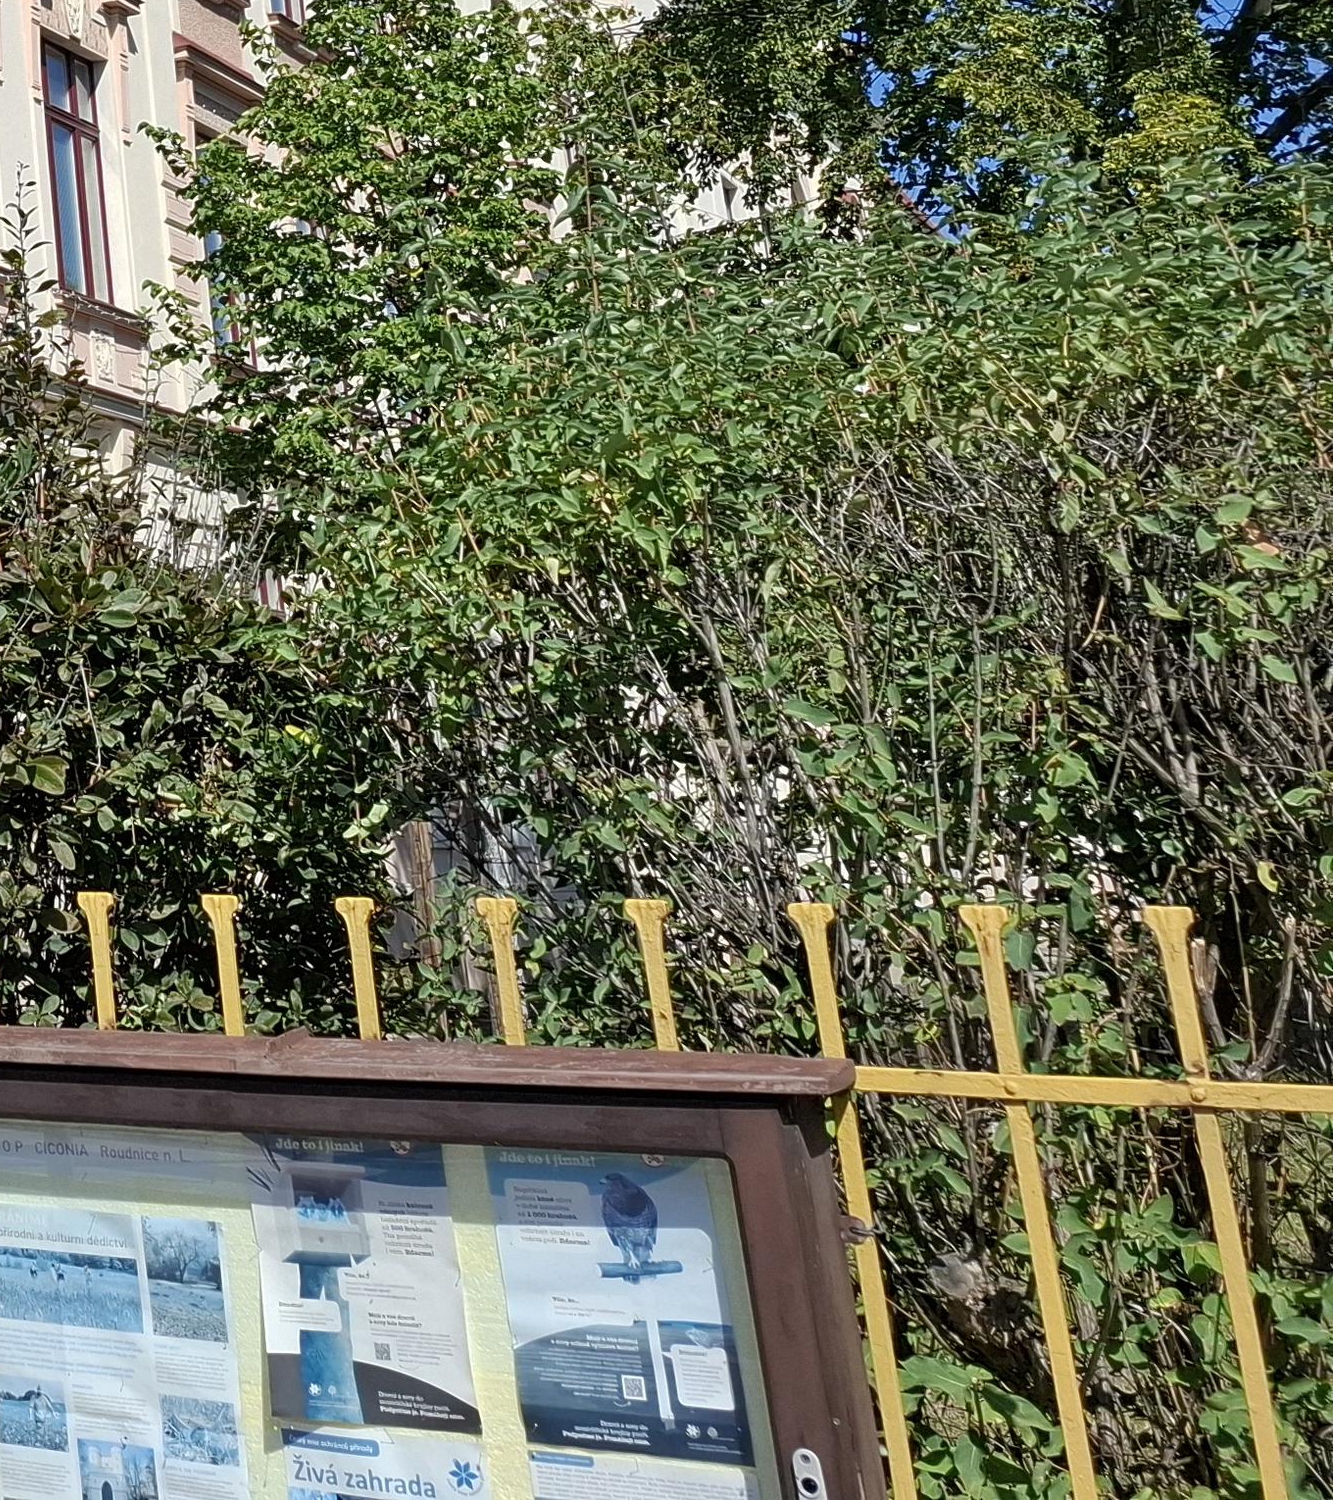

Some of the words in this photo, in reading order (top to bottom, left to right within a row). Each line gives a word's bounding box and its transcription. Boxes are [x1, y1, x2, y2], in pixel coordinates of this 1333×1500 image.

[35, 1140, 89, 1156] CICONIA
[100, 1145, 159, 1161] Roudnice
[164, 1152, 175, 1162] n.
[275, 1138, 299, 1149] Jde
[302, 1140, 317, 1150] to
[324, 1140, 364, 1154] jinak!
[499, 1152, 525, 1164] Jde
[527, 1153, 543, 1164] to
[553, 1154, 595, 1168] jinak!
[37, 1232, 43, 1240] a
[293, 1454, 339, 1486] Živá
[344, 1468, 437, 1498] zahrada
